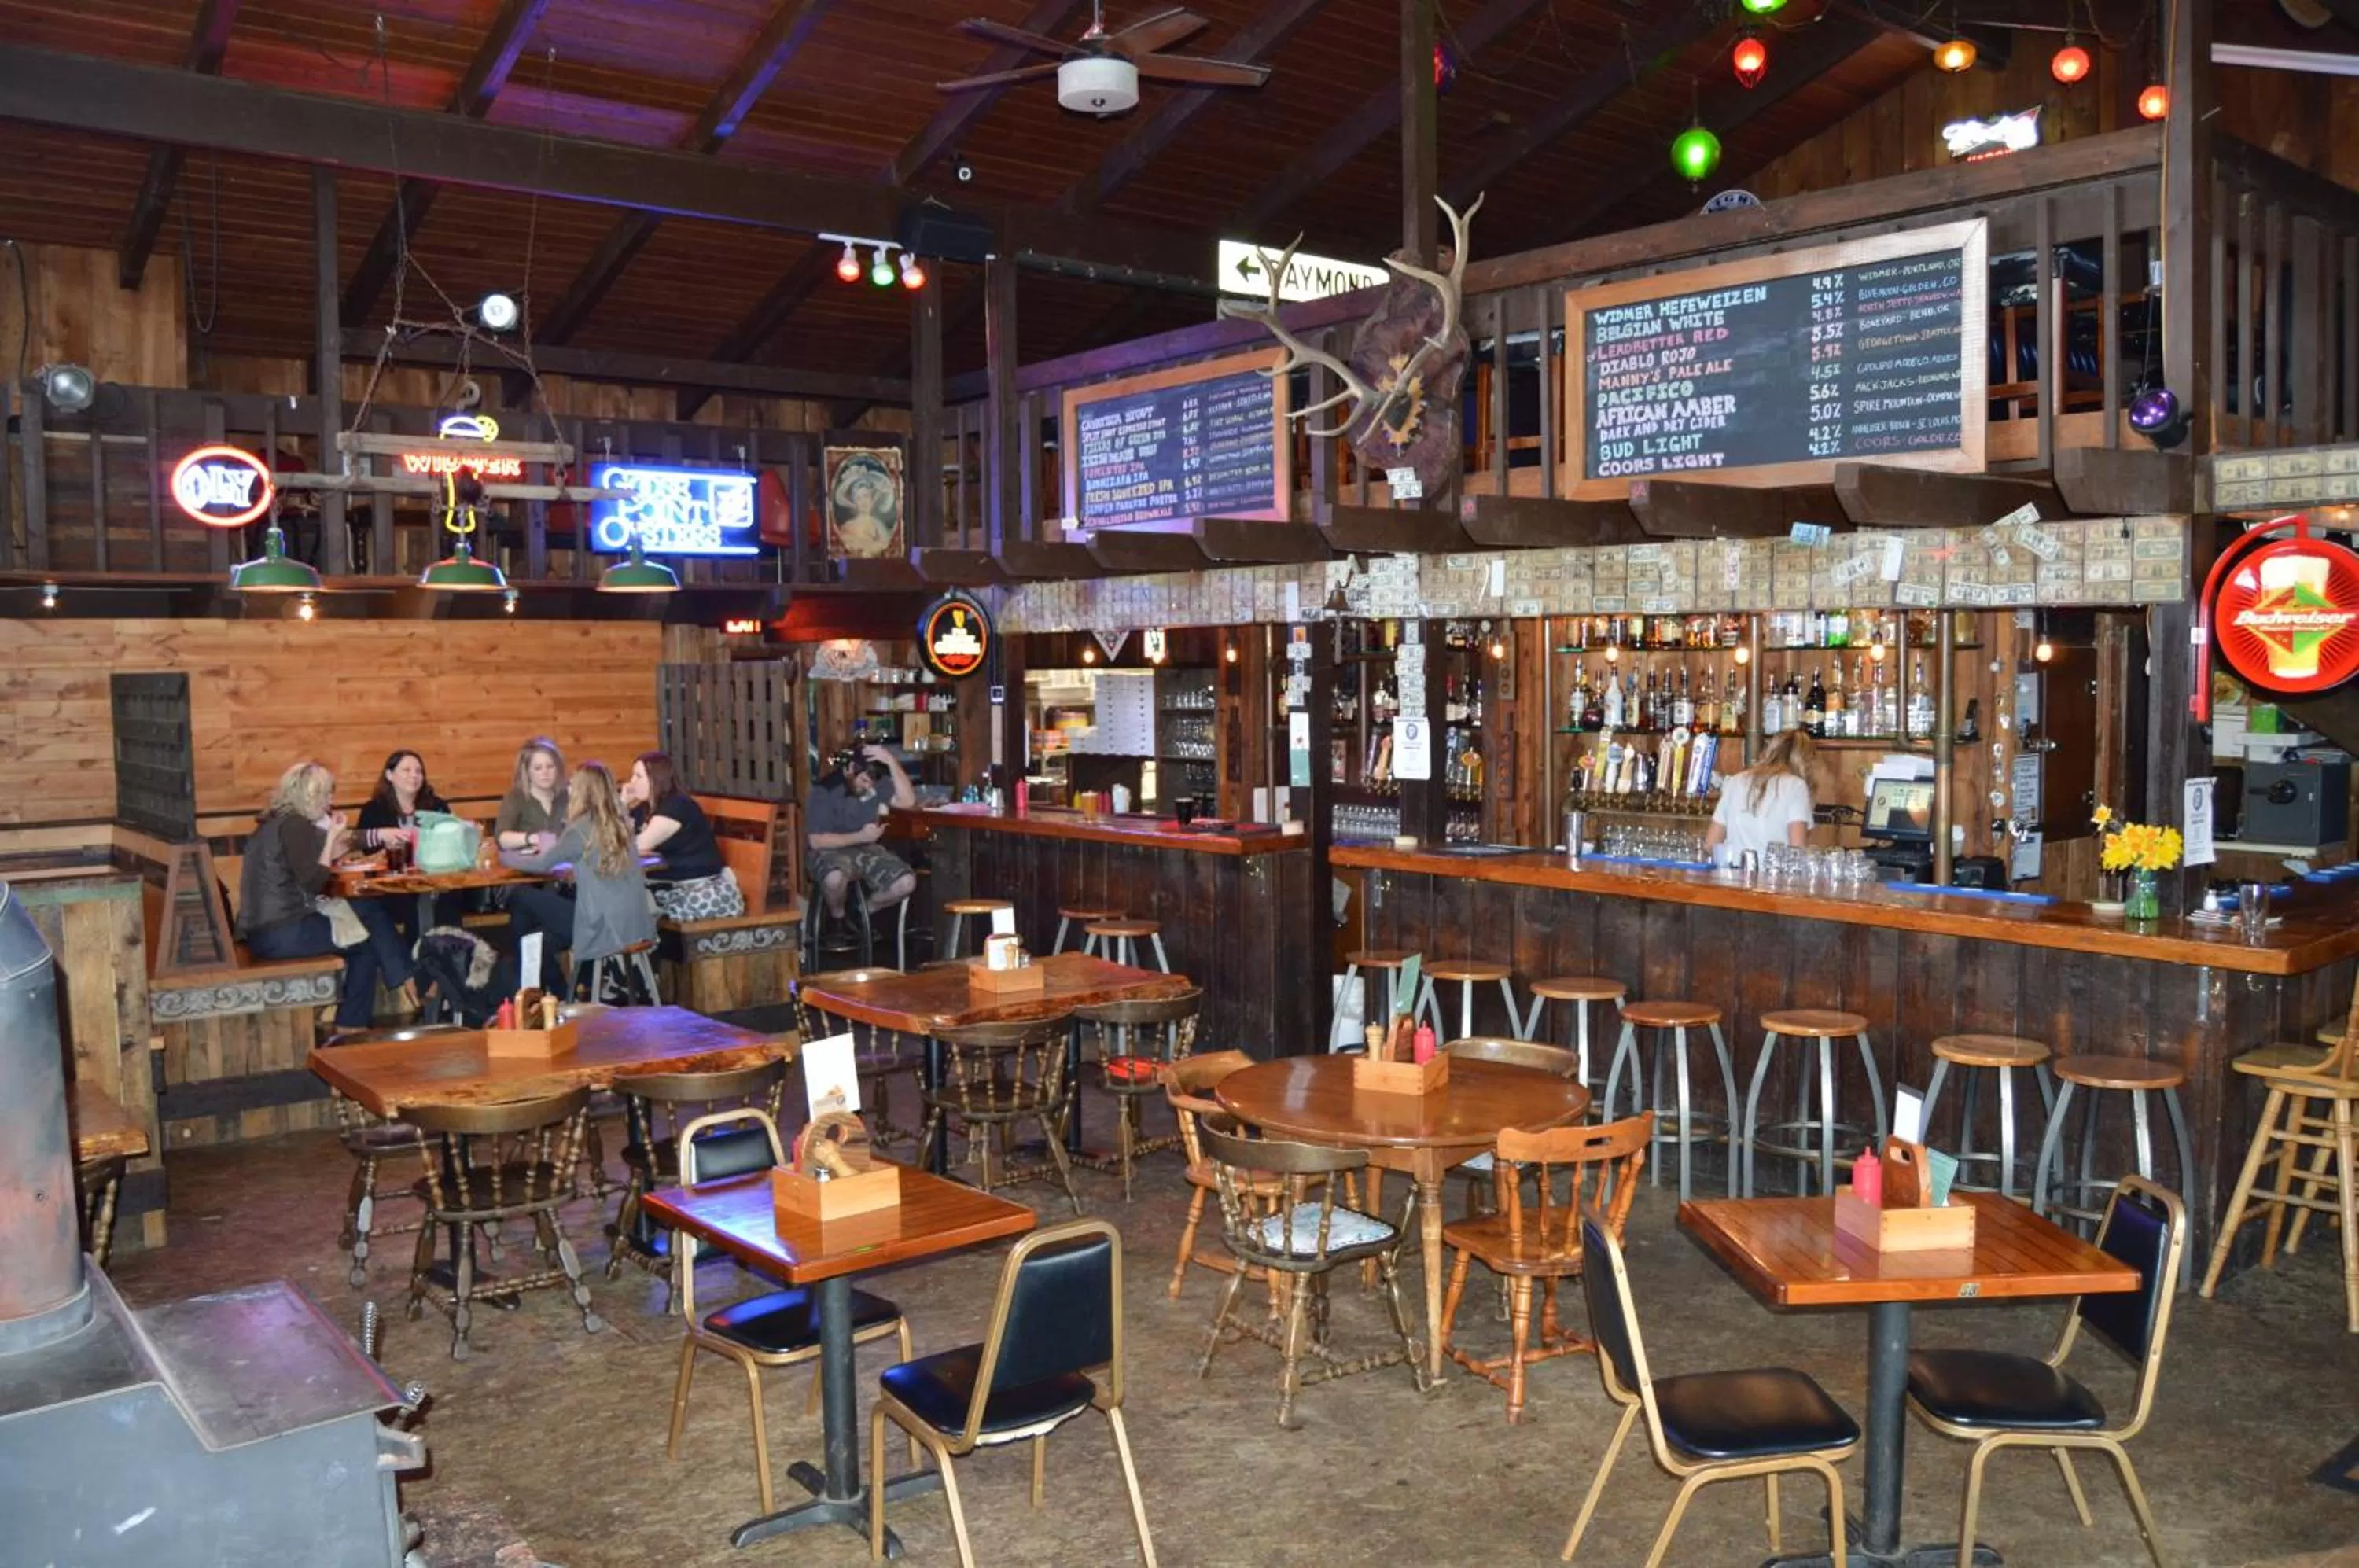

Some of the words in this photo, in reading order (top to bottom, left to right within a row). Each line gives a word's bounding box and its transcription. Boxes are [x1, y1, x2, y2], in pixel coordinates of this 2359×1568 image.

[1594, 303, 1653, 325] WIDMER
[1660, 286, 1768, 315] HEFEWEIZEN
[1596, 319, 1662, 344] BELGIAN
[1669, 310, 1724, 331] WHITE
[1597, 333, 1685, 362] LEADBETTER
[1693, 327, 1729, 344] RED
[1599, 368, 1661, 390] MANNY'S
[1669, 363, 1702, 380] PALE
[1705, 359, 1734, 375] ALE
[1600, 352, 1654, 376] DIABLO
[1662, 347, 1696, 365] ROJO
[1597, 380, 1694, 407] PACIFICO
[1595, 403, 1668, 429] AFRICAN
[1672, 395, 1736, 419] AMBER
[1600, 426, 1630, 443] DARK
[1633, 421, 1658, 436] AND
[1664, 418, 1685, 432] DRY
[1691, 414, 1726, 430] CIDER
[1809, 403, 1842, 421] 5.0%
[1599, 442, 1634, 461] BUD
[1643, 433, 1703, 455] LIGHT
[1598, 456, 1654, 477] COORS
[1662, 452, 1724, 469] LIGHT
[180, 464, 259, 510] OLY
[2234, 609, 2357, 626] Budweiser
